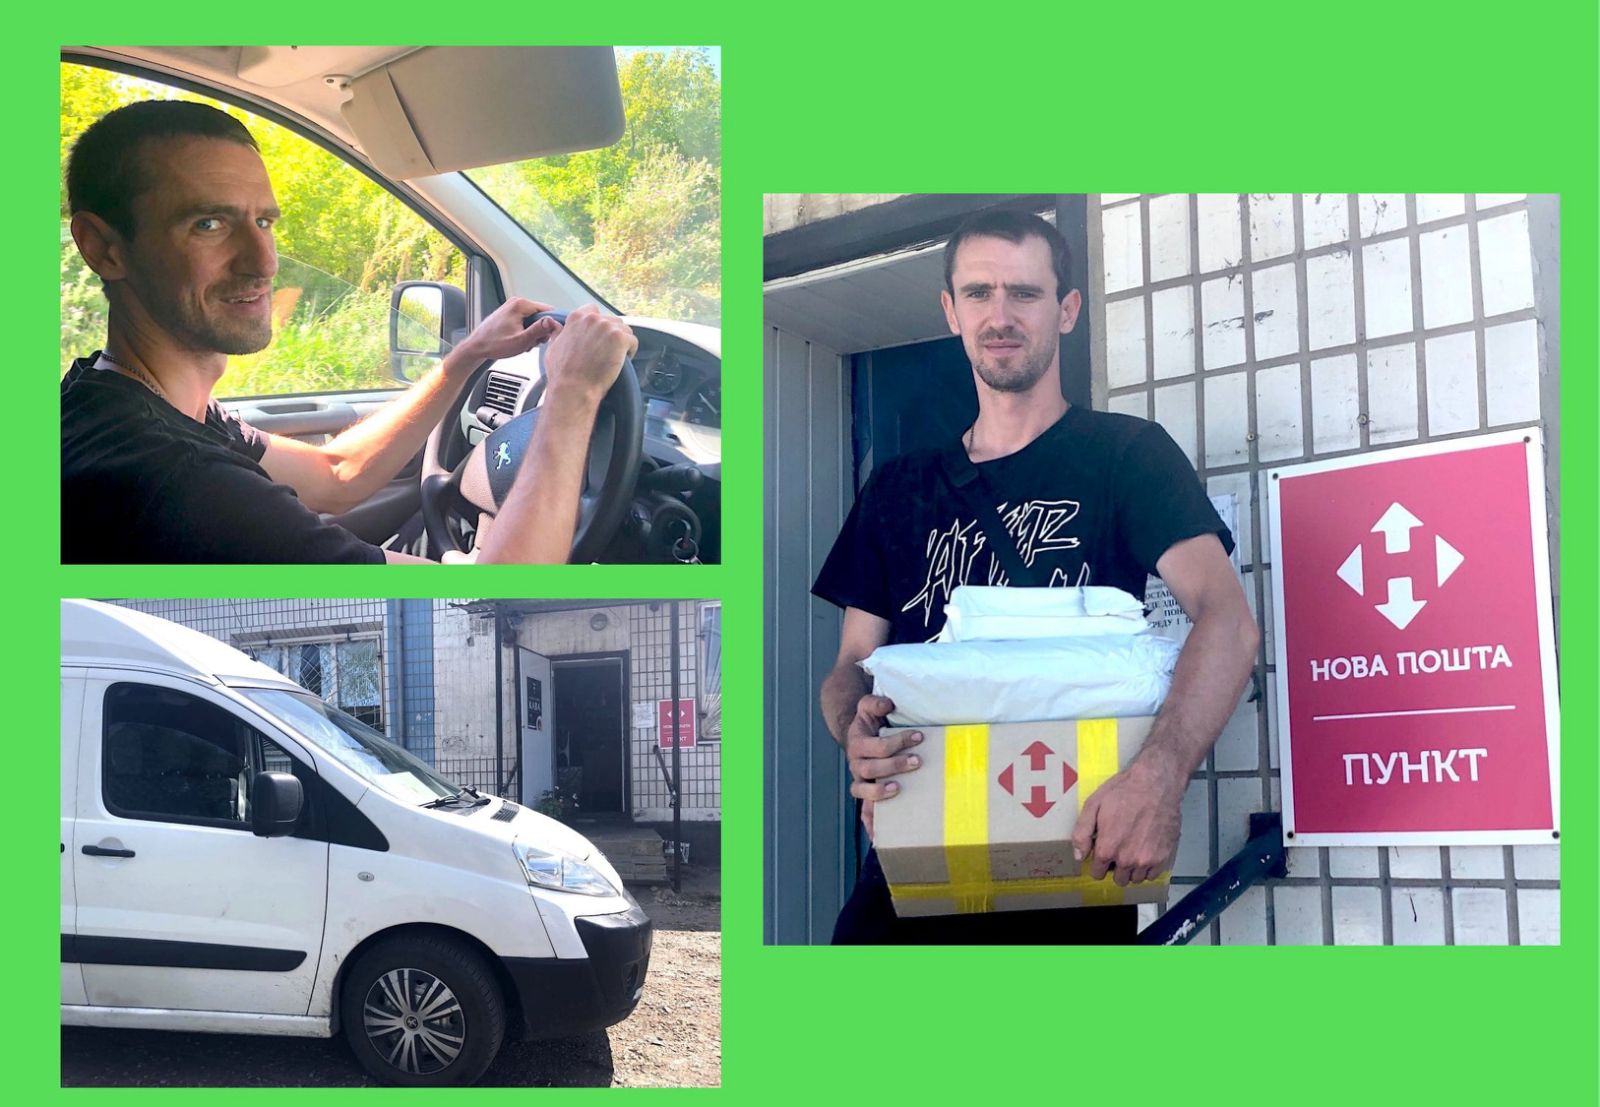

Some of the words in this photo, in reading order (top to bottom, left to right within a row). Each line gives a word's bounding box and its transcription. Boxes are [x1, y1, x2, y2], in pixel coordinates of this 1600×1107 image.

[1148, 619, 1173, 628] РЕДУ
[1310, 654, 1389, 682] НОВА
[1396, 644, 1513, 675] ПОШТА
[1342, 748, 1488, 785] ПУНКТ
